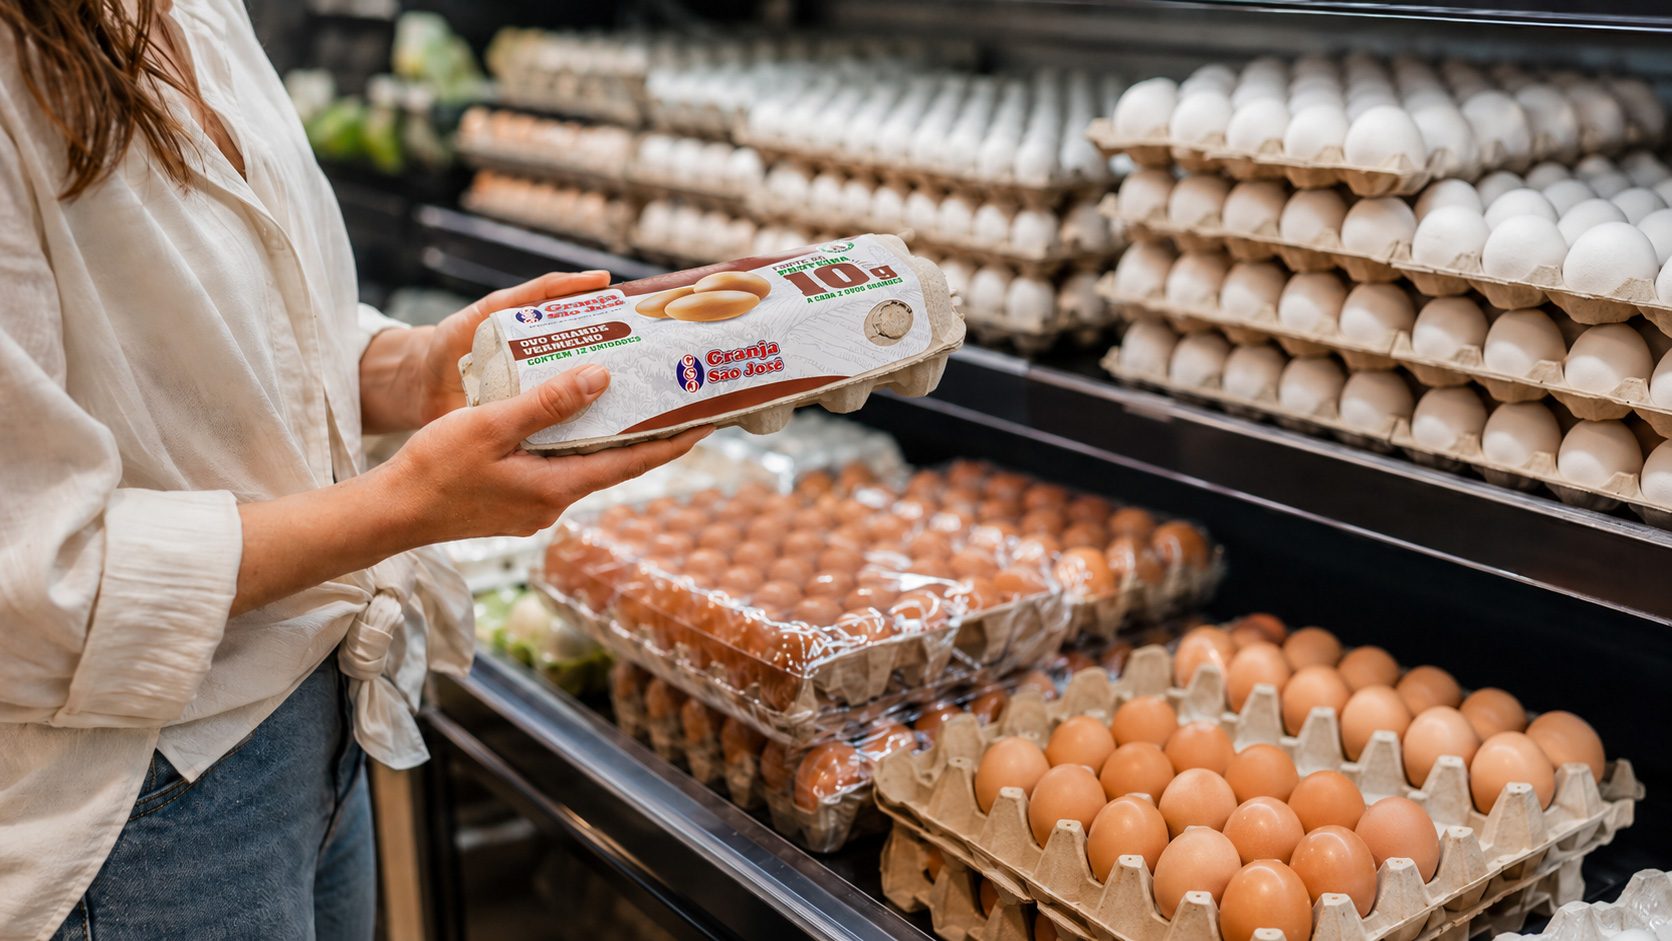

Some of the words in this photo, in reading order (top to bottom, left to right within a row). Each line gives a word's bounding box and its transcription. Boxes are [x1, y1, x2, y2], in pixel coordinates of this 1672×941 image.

[783, 263, 898, 297] 10g
[544, 294, 619, 312] Granja
[519, 337, 548, 348] OVO
[550, 324, 609, 341] GRANDE
[576, 347, 588, 355] 12
[705, 340, 780, 367] Granja
